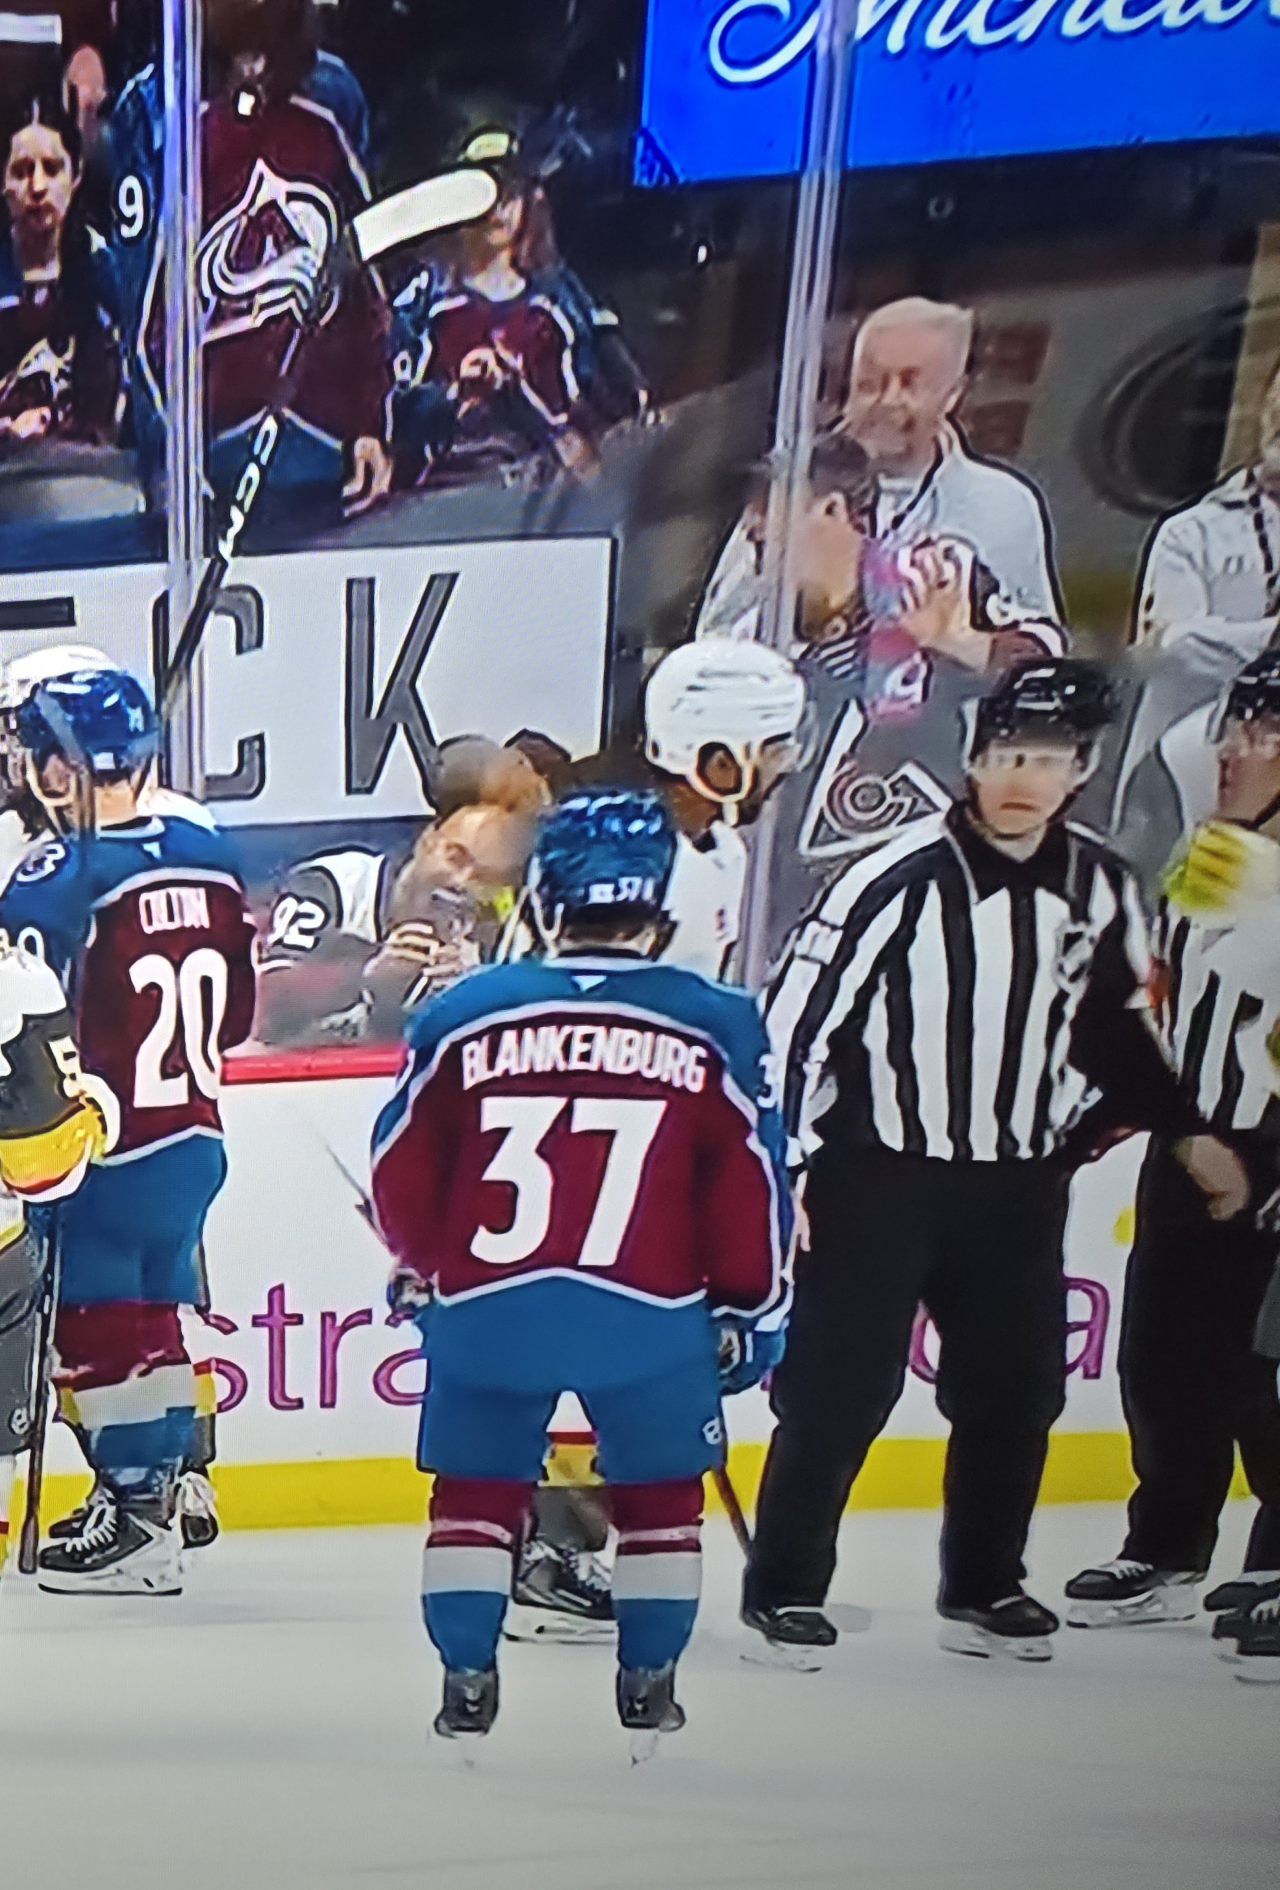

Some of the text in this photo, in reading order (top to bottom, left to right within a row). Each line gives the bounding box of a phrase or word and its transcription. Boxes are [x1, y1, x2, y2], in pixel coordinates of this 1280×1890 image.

[128, 947, 228, 1108] 20
[462, 1024, 708, 1093] BLANKENBURG
[470, 1095, 668, 1266] 37
